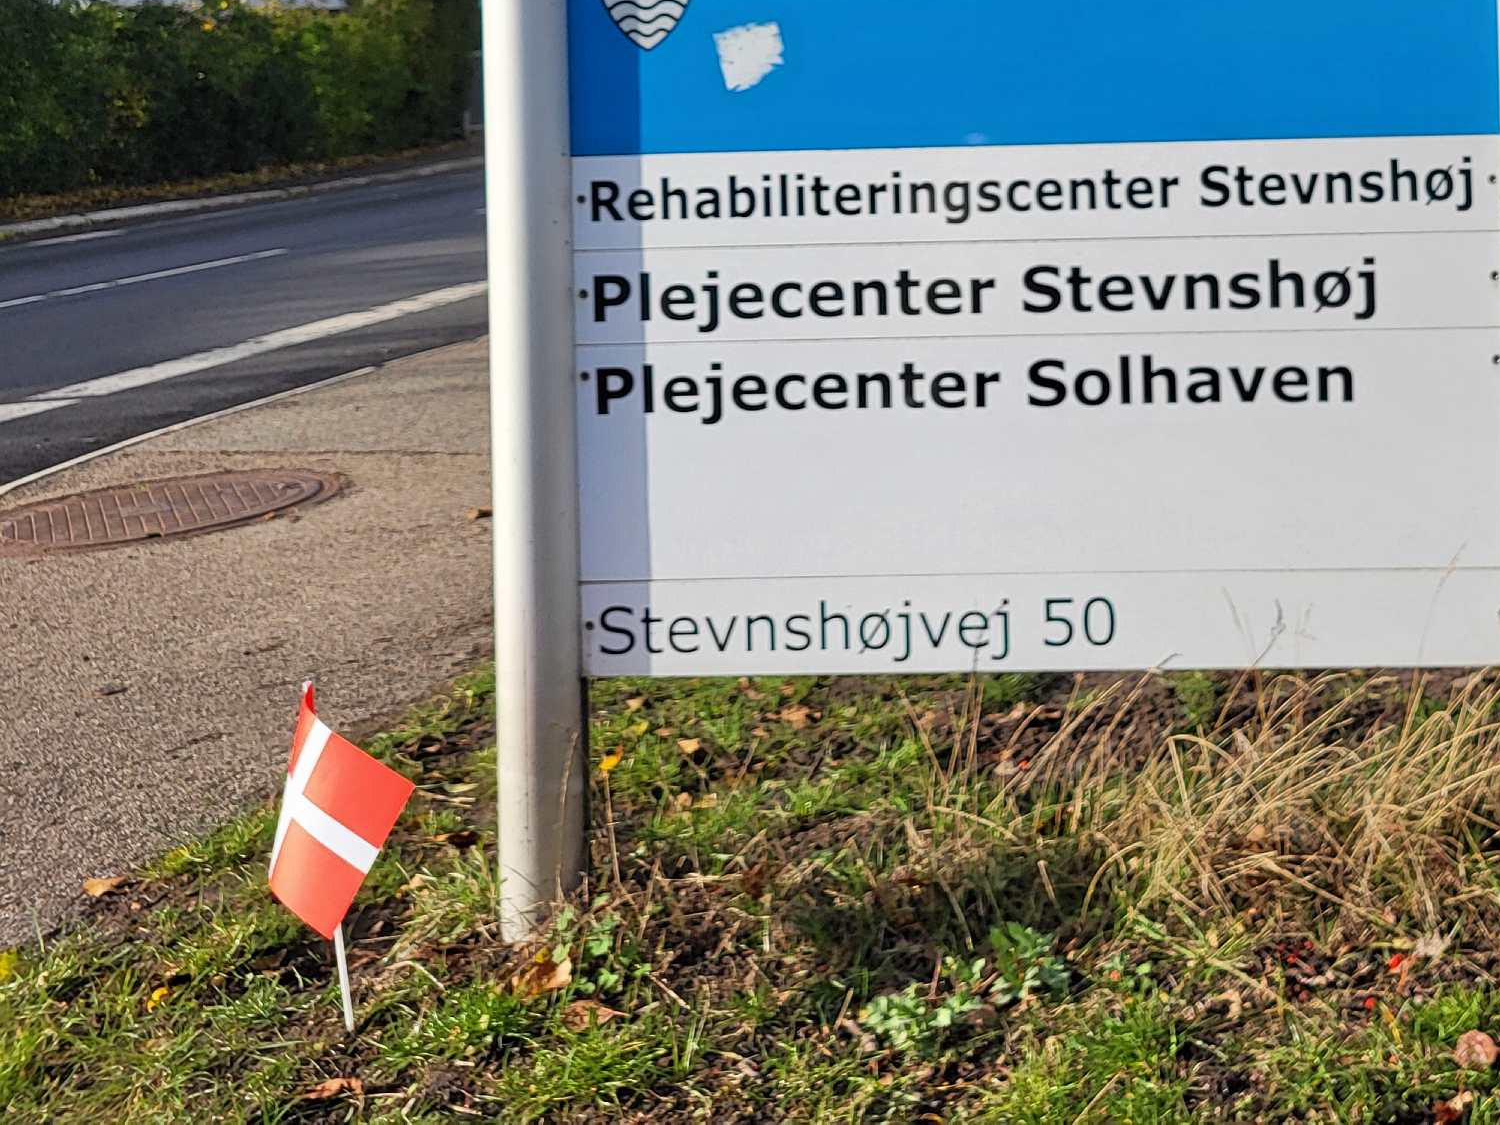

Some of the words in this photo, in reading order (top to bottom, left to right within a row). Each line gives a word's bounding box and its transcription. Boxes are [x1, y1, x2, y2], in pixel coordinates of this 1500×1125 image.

[590, 168, 1179, 223] Rehabiliteringscenter
[1199, 156, 1474, 212] Stevnshøj
[593, 269, 995, 333] Plejecenter
[1022, 256, 1378, 320] Stevnshøj
[595, 361, 1000, 425] Plejecenter
[1027, 354, 1355, 407] Solhaven
[598, 599, 1011, 662] Stevnshøjvej
[1043, 596, 1116, 647] 50
